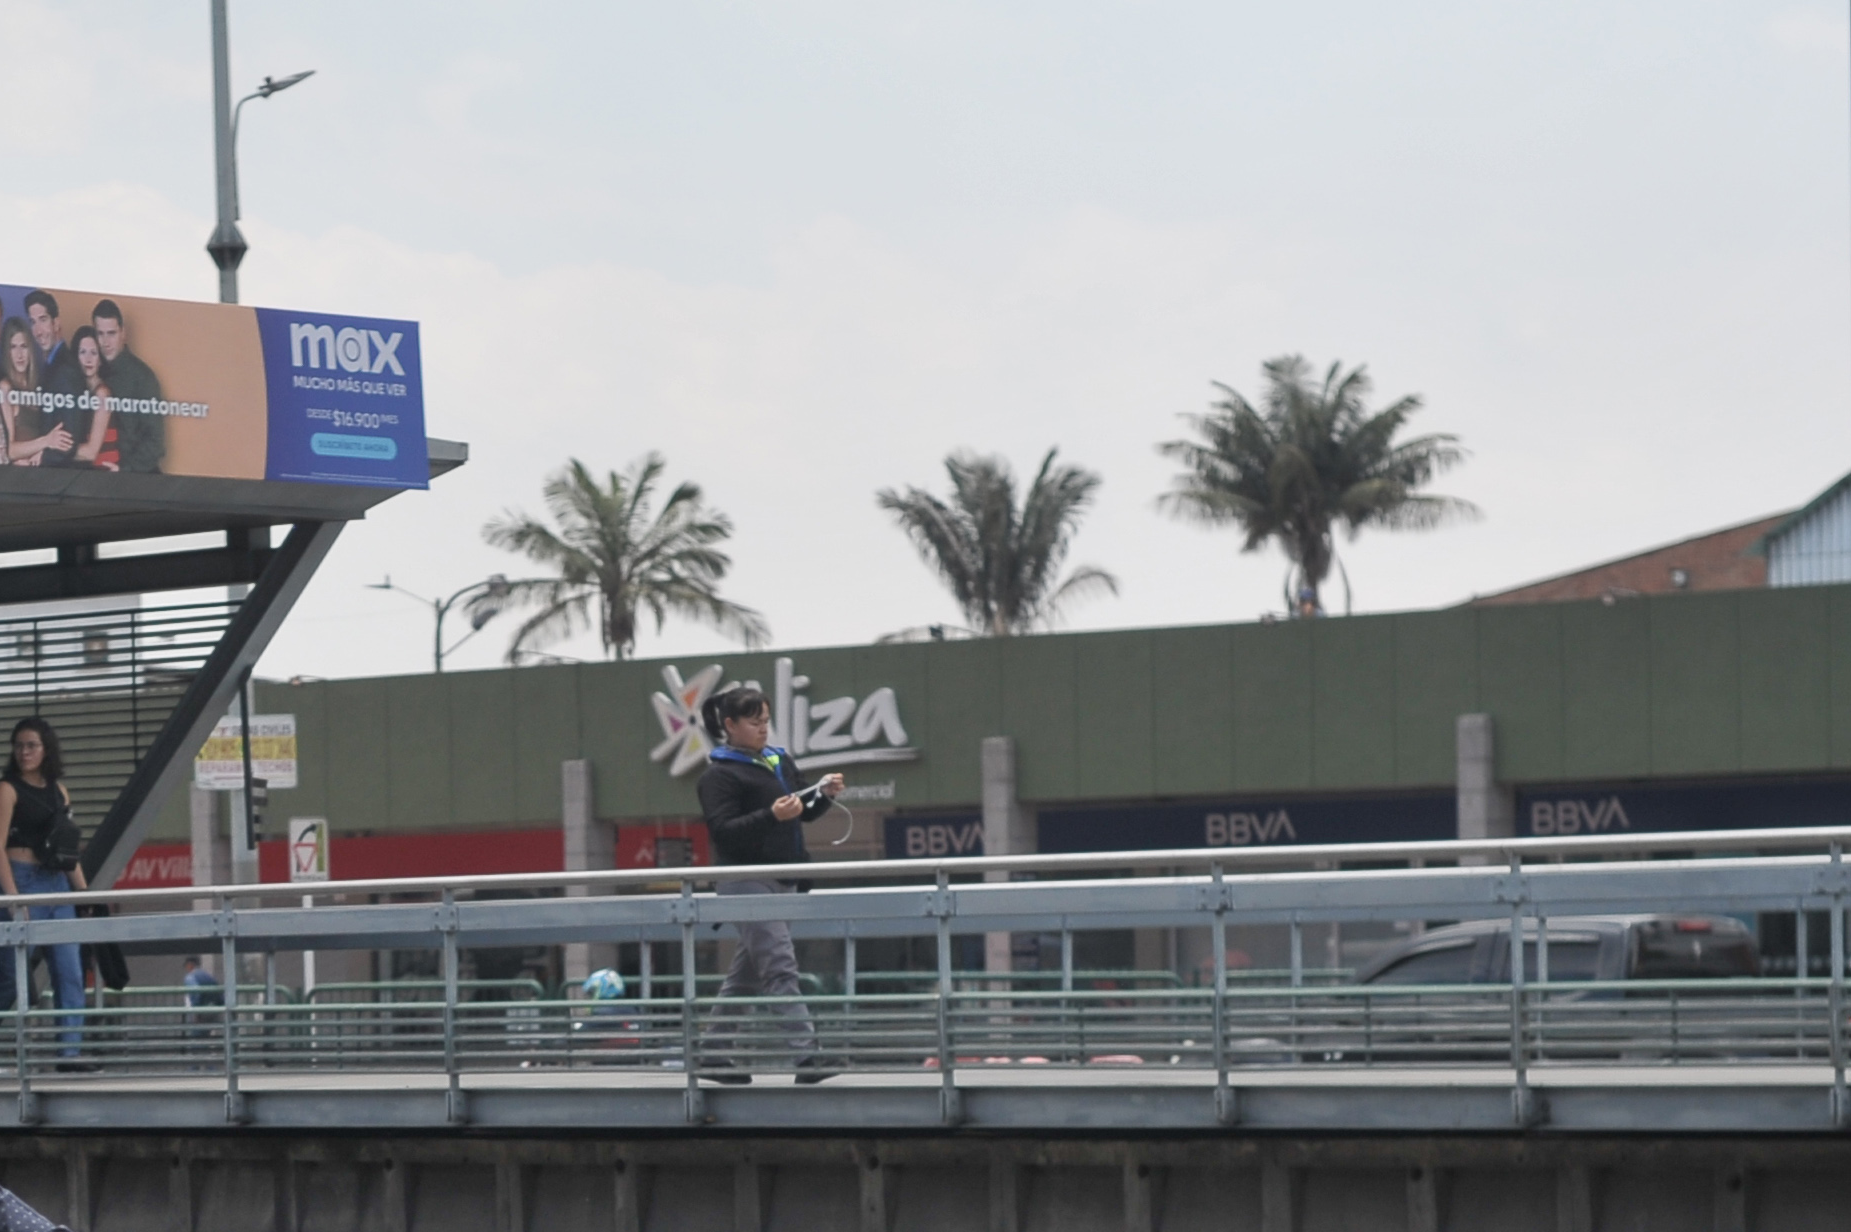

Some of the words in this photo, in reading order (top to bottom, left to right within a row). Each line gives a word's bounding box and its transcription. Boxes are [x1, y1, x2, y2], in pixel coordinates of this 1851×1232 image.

[290, 322, 405, 376] max
[7, 385, 75, 413] amigos
[77, 389, 101, 410] de
[104, 396, 210, 418] maratonear
[293, 374, 335, 391] MUCHO
[336, 376, 361, 393] MÁS
[362, 381, 385, 395] QUE
[385, 383, 407, 396] VER
[1206, 808, 1297, 846] BBVA
[1531, 796, 1631, 835] BBVA
